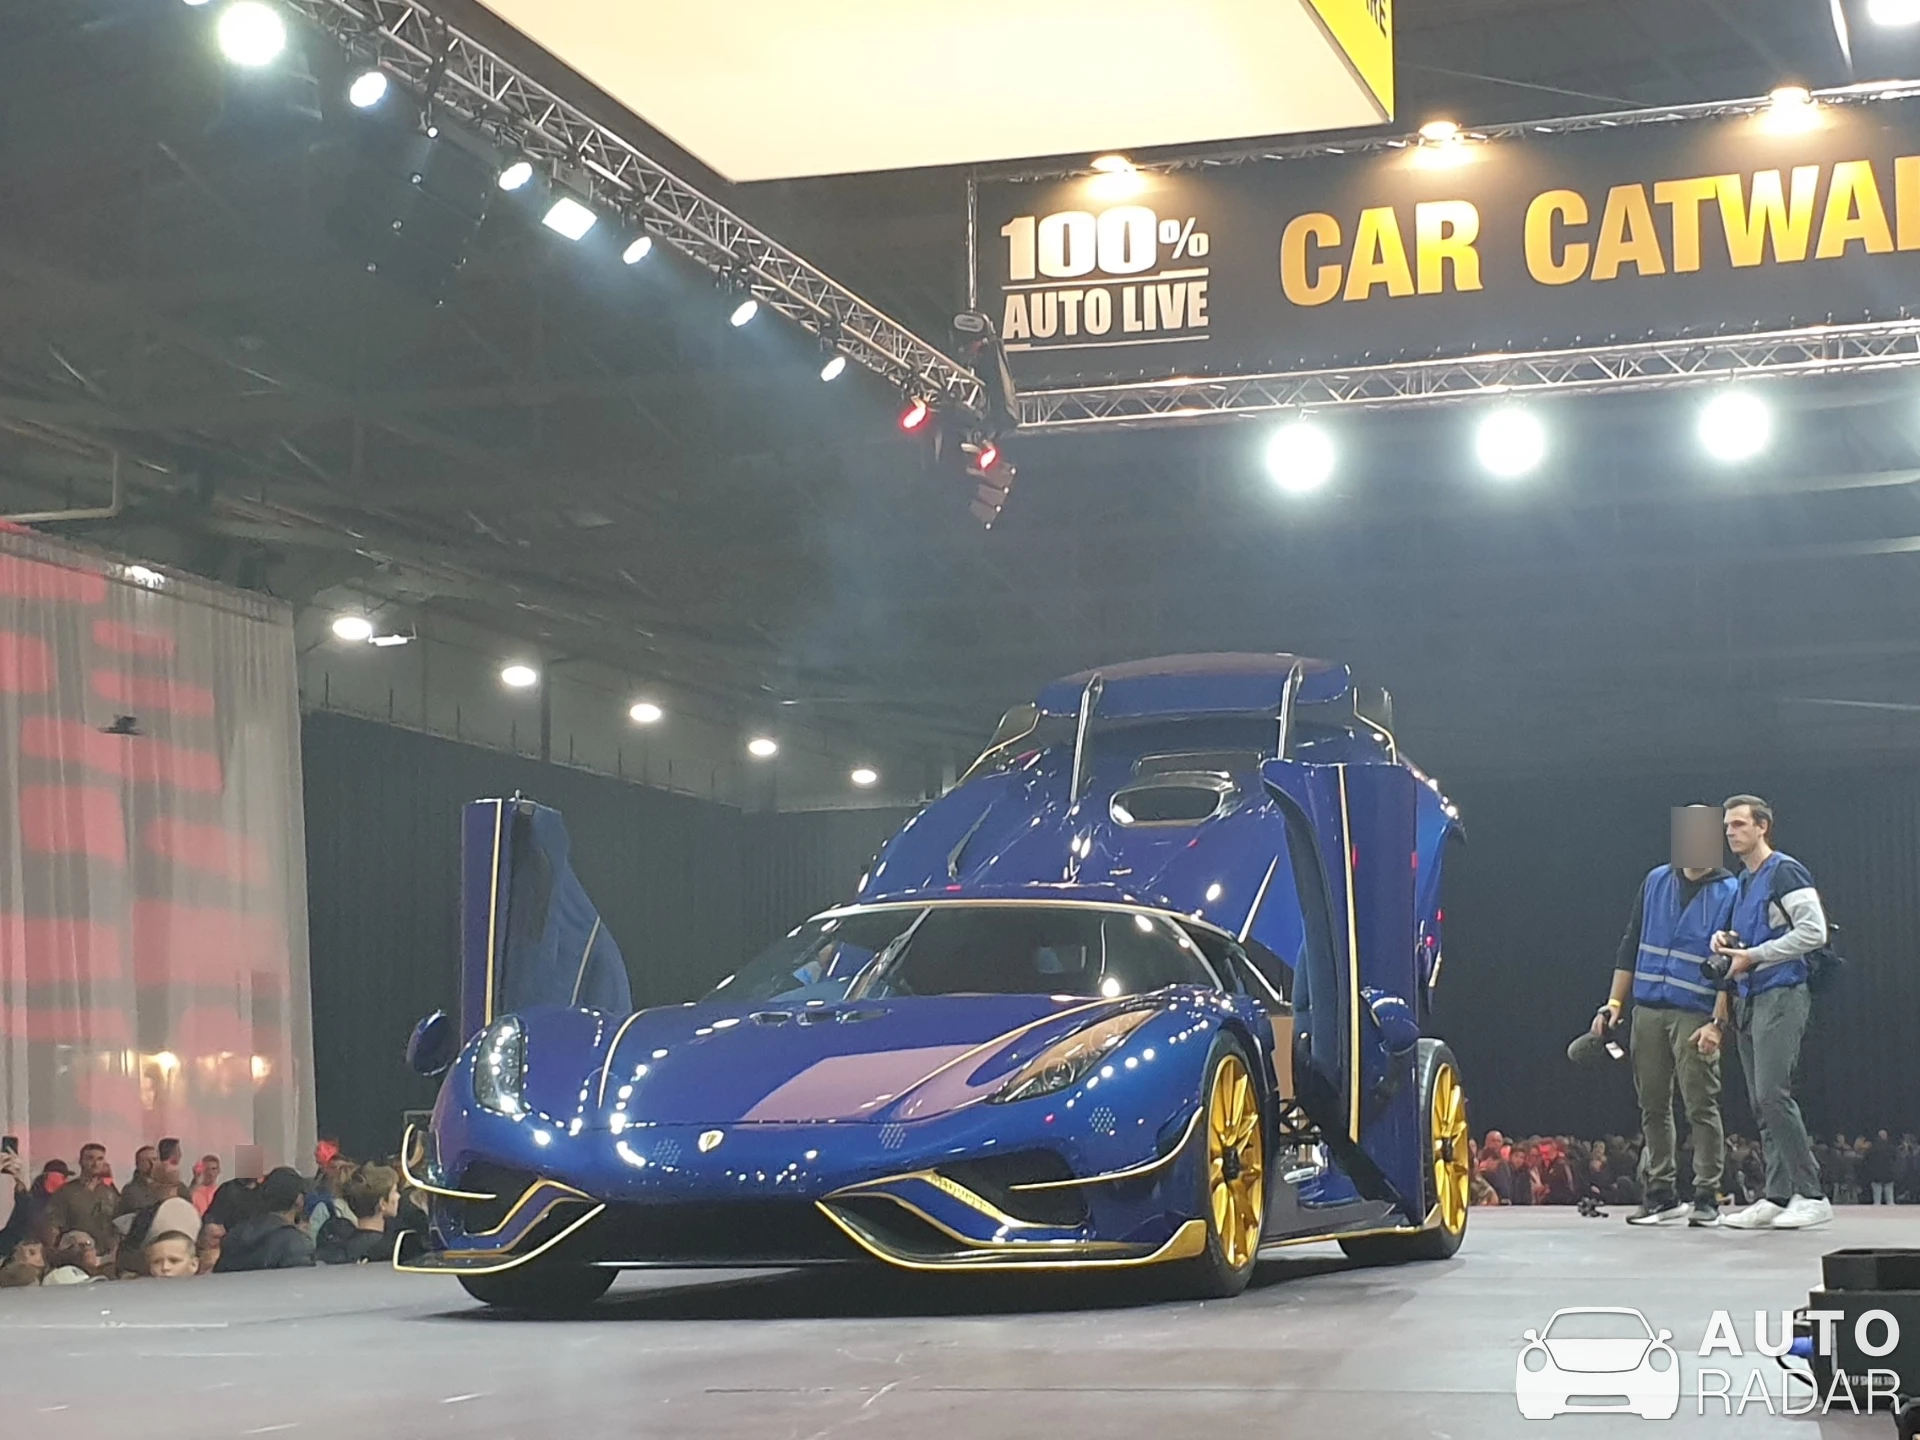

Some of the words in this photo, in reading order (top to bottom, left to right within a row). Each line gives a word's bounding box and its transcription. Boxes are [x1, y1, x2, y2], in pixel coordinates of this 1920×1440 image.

[1001, 205, 1209, 281] 100%
[1280, 199, 1484, 306] CAR
[1002, 287, 1112, 339] AUTO
[1122, 281, 1209, 333] LIVE
